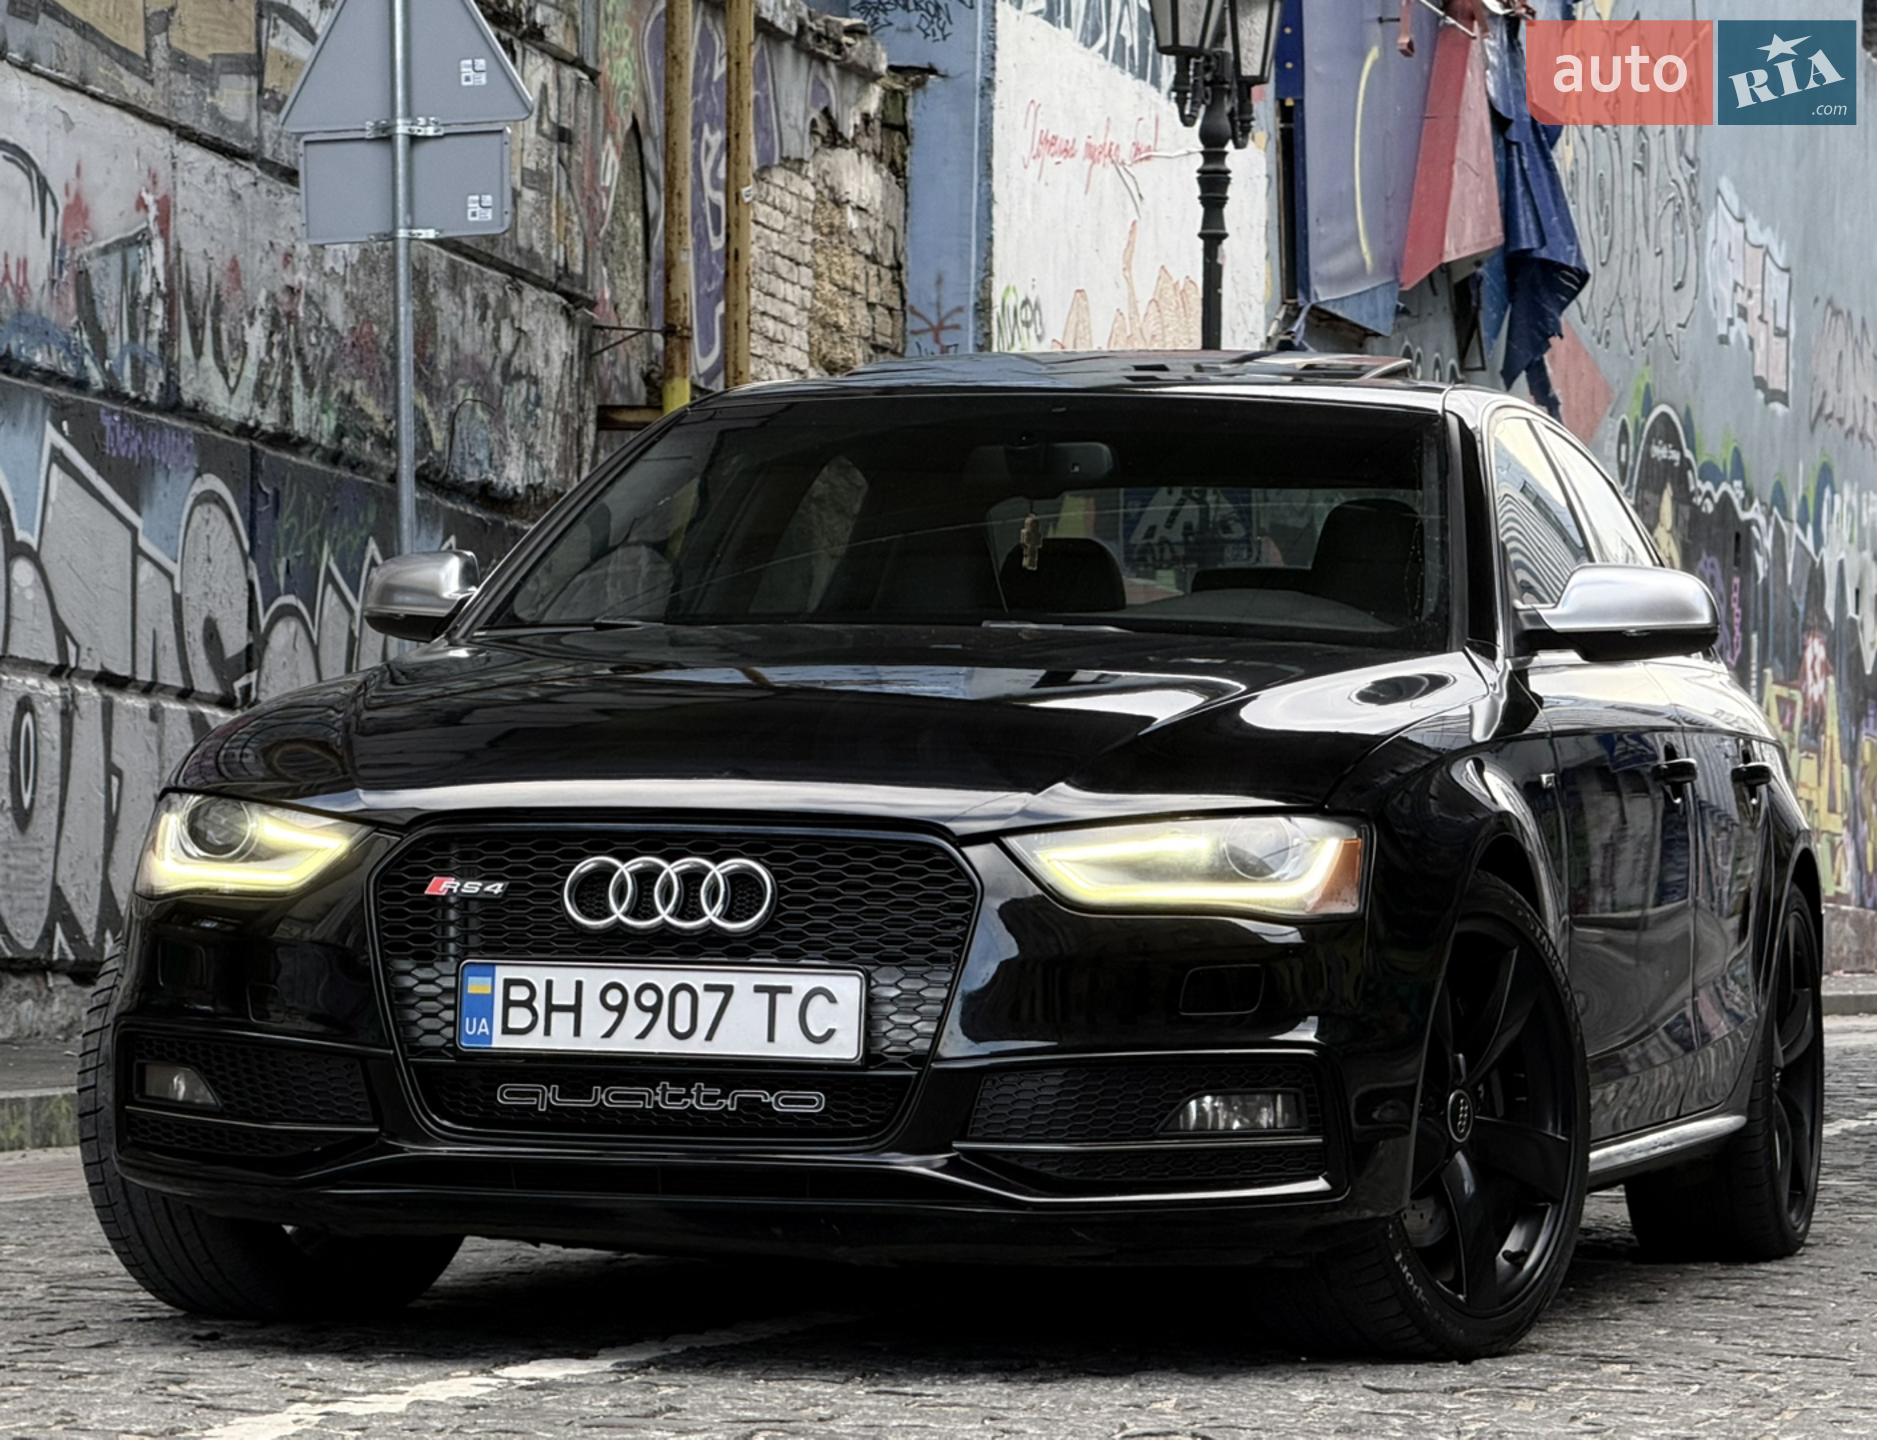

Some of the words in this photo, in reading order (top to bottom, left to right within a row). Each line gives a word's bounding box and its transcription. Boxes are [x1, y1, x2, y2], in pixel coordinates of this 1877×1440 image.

[439, 880, 505, 895] RS4
[500, 977, 584, 1038] BH
[599, 981, 735, 1042] 9907
[753, 984, 838, 1045] TC
[464, 1017, 490, 1036] UA
[496, 1081, 826, 1113] quattro
